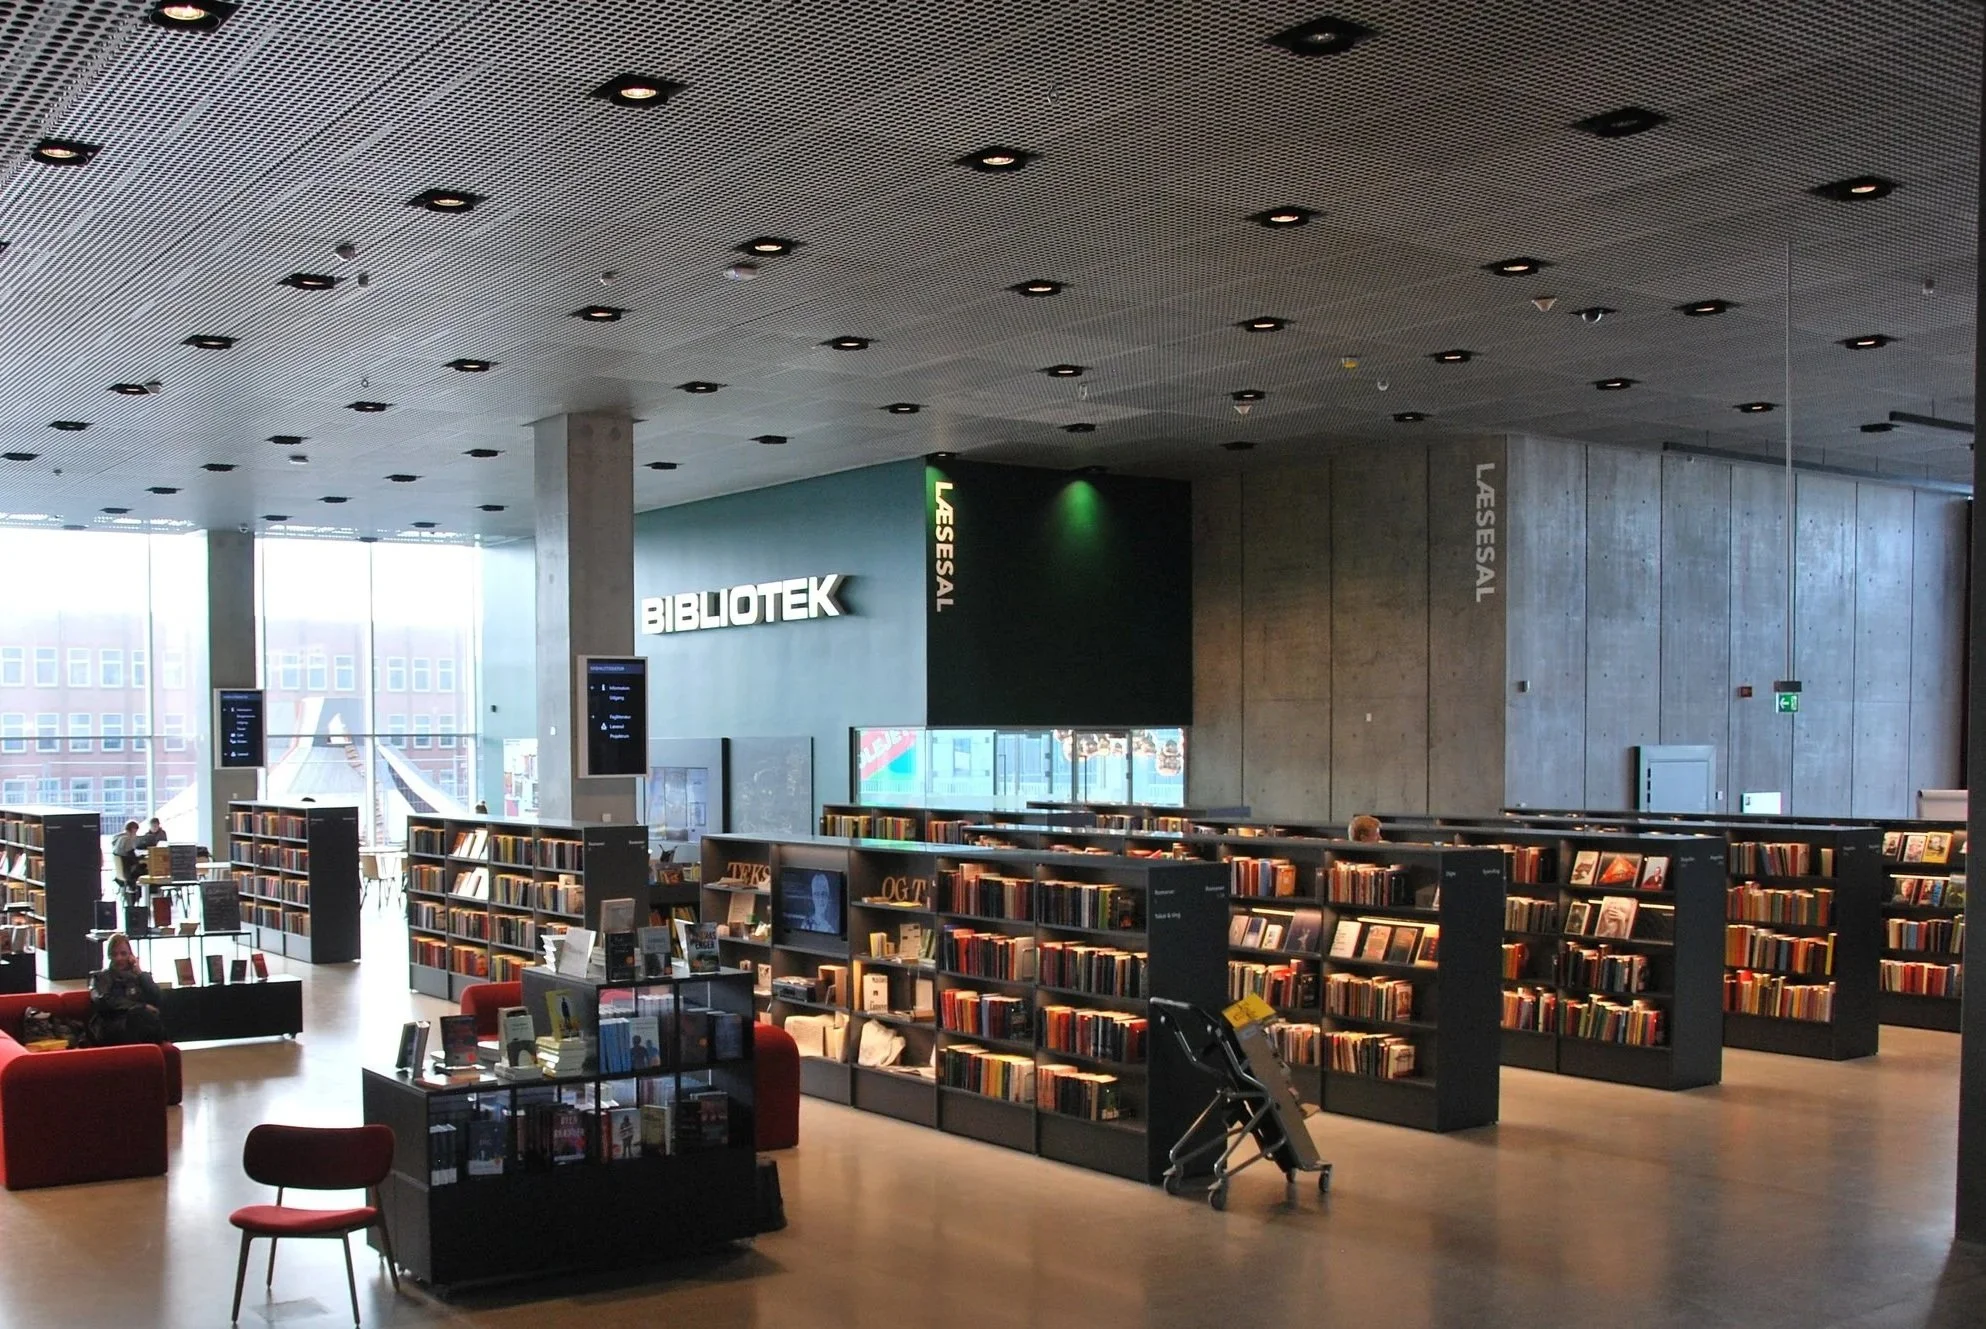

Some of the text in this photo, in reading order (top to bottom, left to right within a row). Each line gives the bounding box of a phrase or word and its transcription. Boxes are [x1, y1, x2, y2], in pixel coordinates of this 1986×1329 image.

[935, 481, 954, 612] LÆSESAL
[1476, 463, 1496, 602] LÆSESAL
[641, 573, 841, 635] BIBLIOTEK
[882, 876, 909, 902] OG
